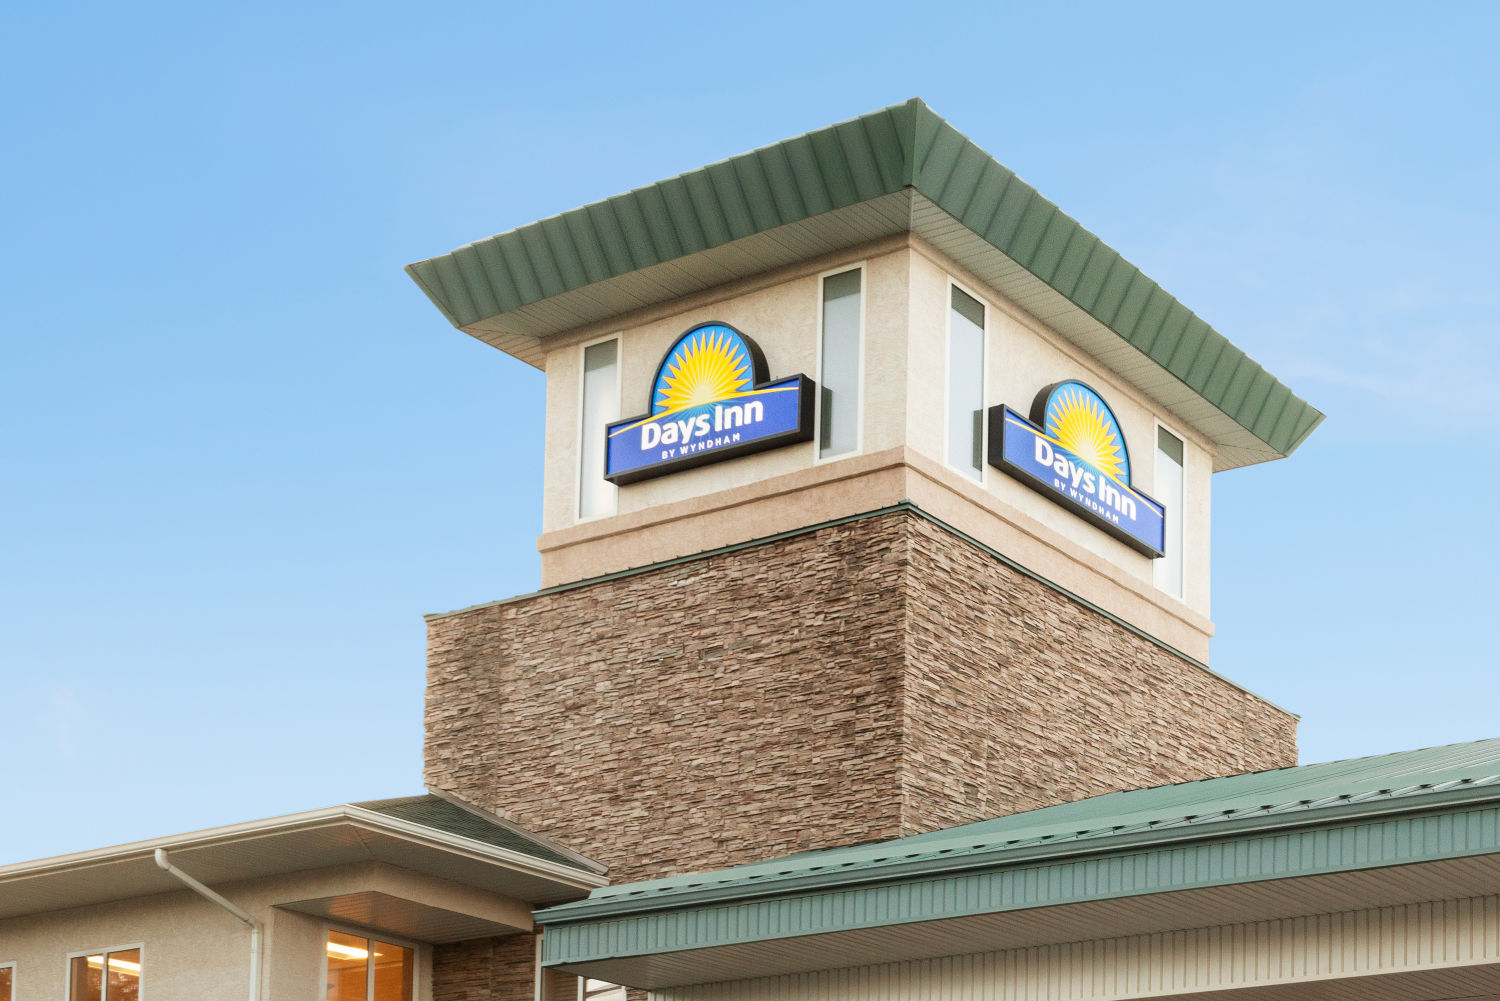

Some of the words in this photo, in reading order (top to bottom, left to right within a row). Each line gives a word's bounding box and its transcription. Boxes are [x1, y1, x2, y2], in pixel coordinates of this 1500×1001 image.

[641, 413, 710, 451] Days
[715, 401, 764, 432] Inn
[661, 449, 676, 460] BY
[680, 433, 741, 454] WYNDHAM
[1034, 436, 1096, 494] Days
[1099, 475, 1137, 521] Inn
[1054, 478, 1066, 492] BY
[1070, 487, 1119, 524] WYNDHAM
